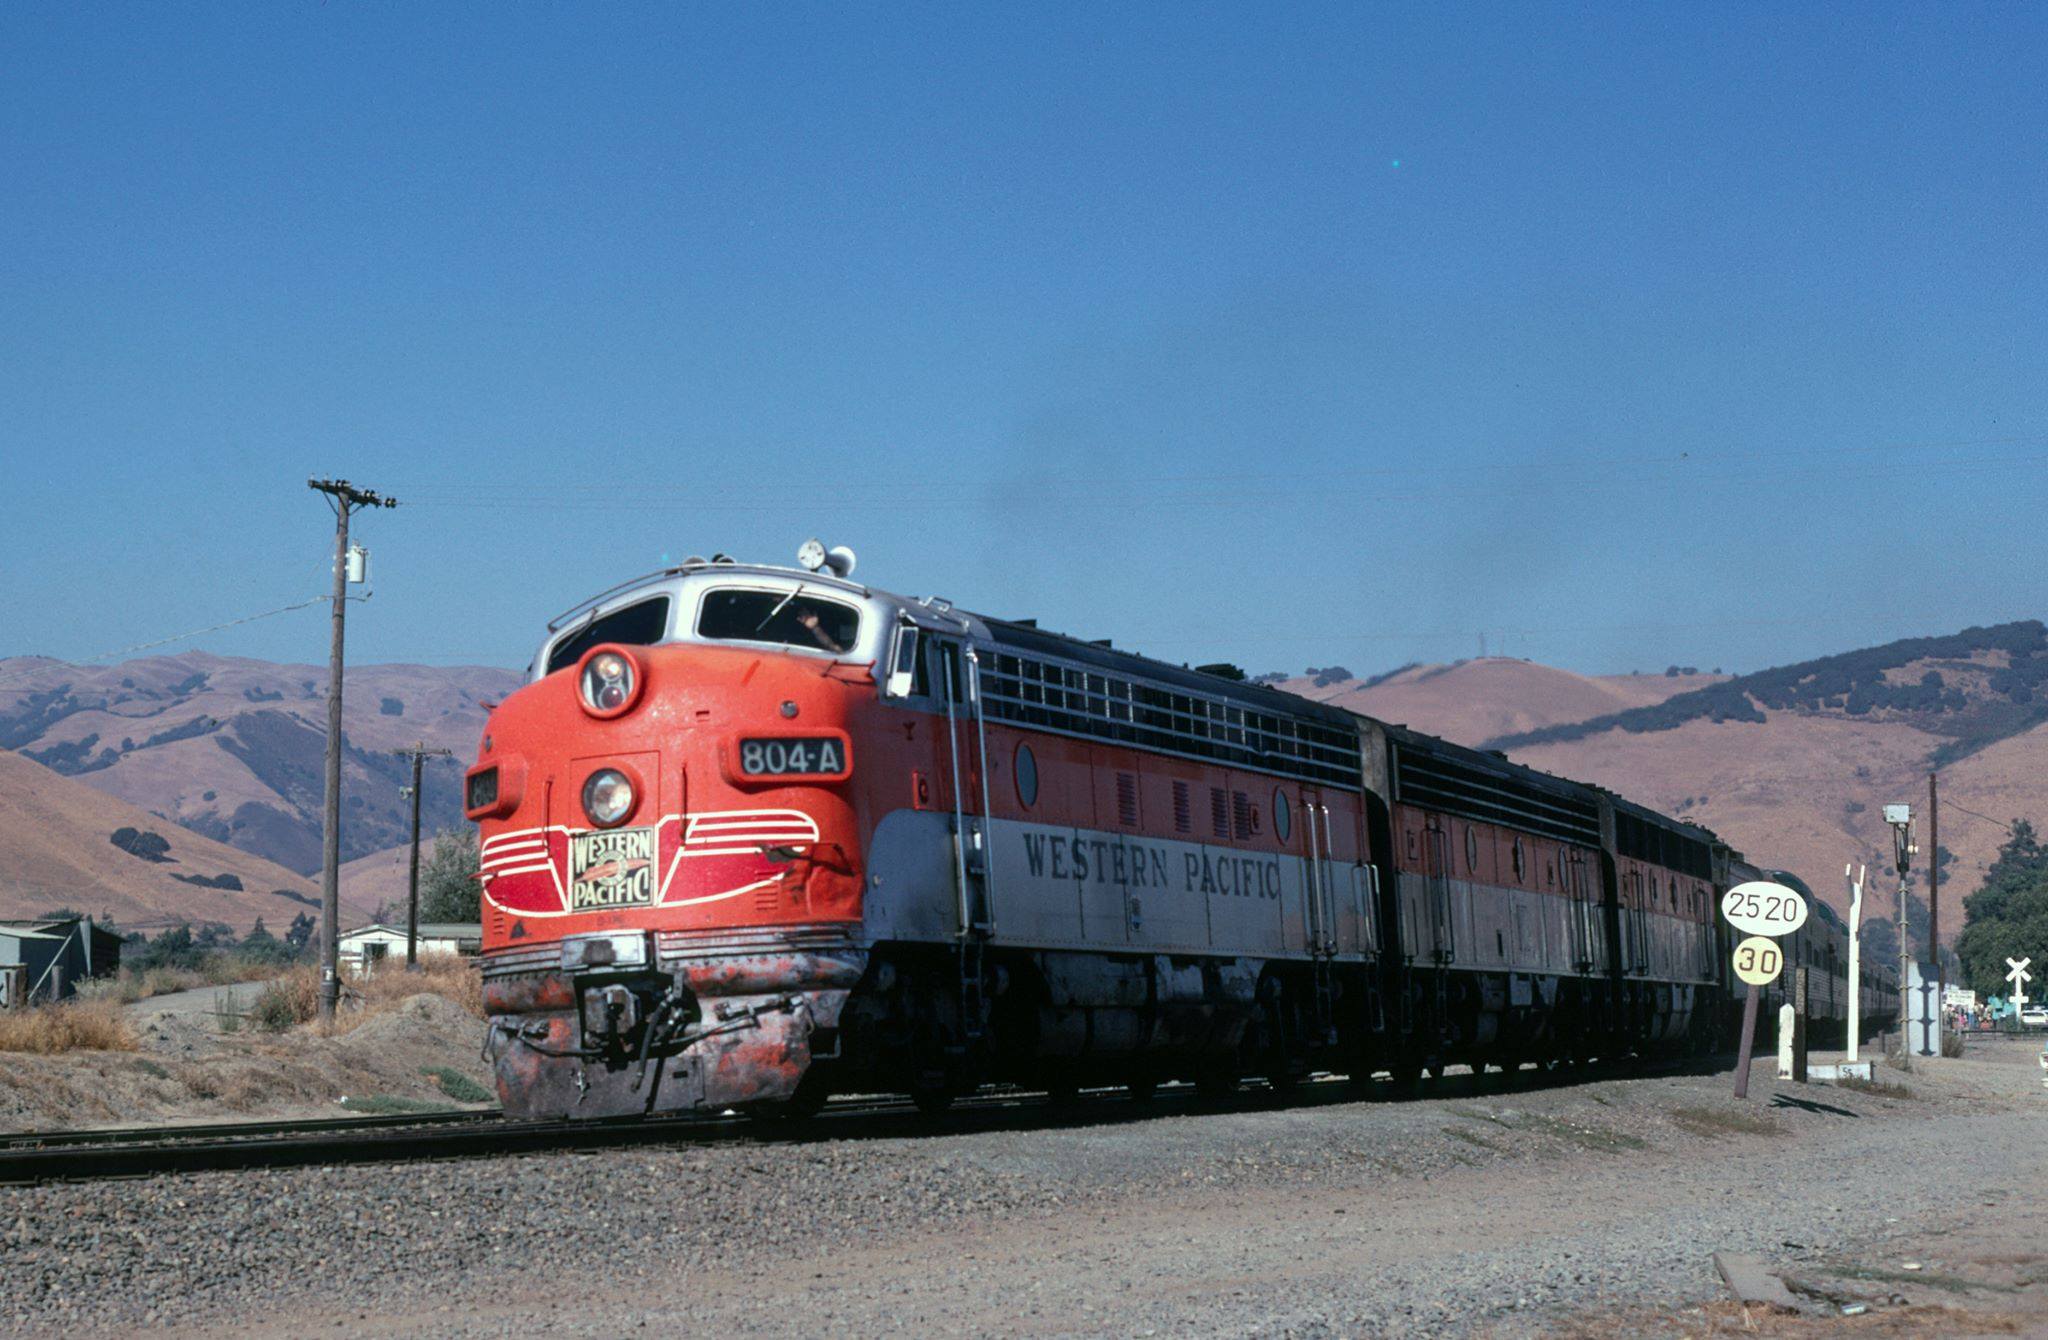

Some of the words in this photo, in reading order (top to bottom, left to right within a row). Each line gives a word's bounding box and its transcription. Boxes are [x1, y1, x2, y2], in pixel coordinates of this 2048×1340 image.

[743, 741, 840, 774] 804-A
[574, 831, 651, 874] WESTERN
[1023, 832, 1168, 888] WESTERN
[1184, 852, 1280, 900] PACIFIC
[573, 867, 650, 907] PACIFIC
[1728, 892, 1797, 922] 2520
[1738, 947, 1777, 974] 30
